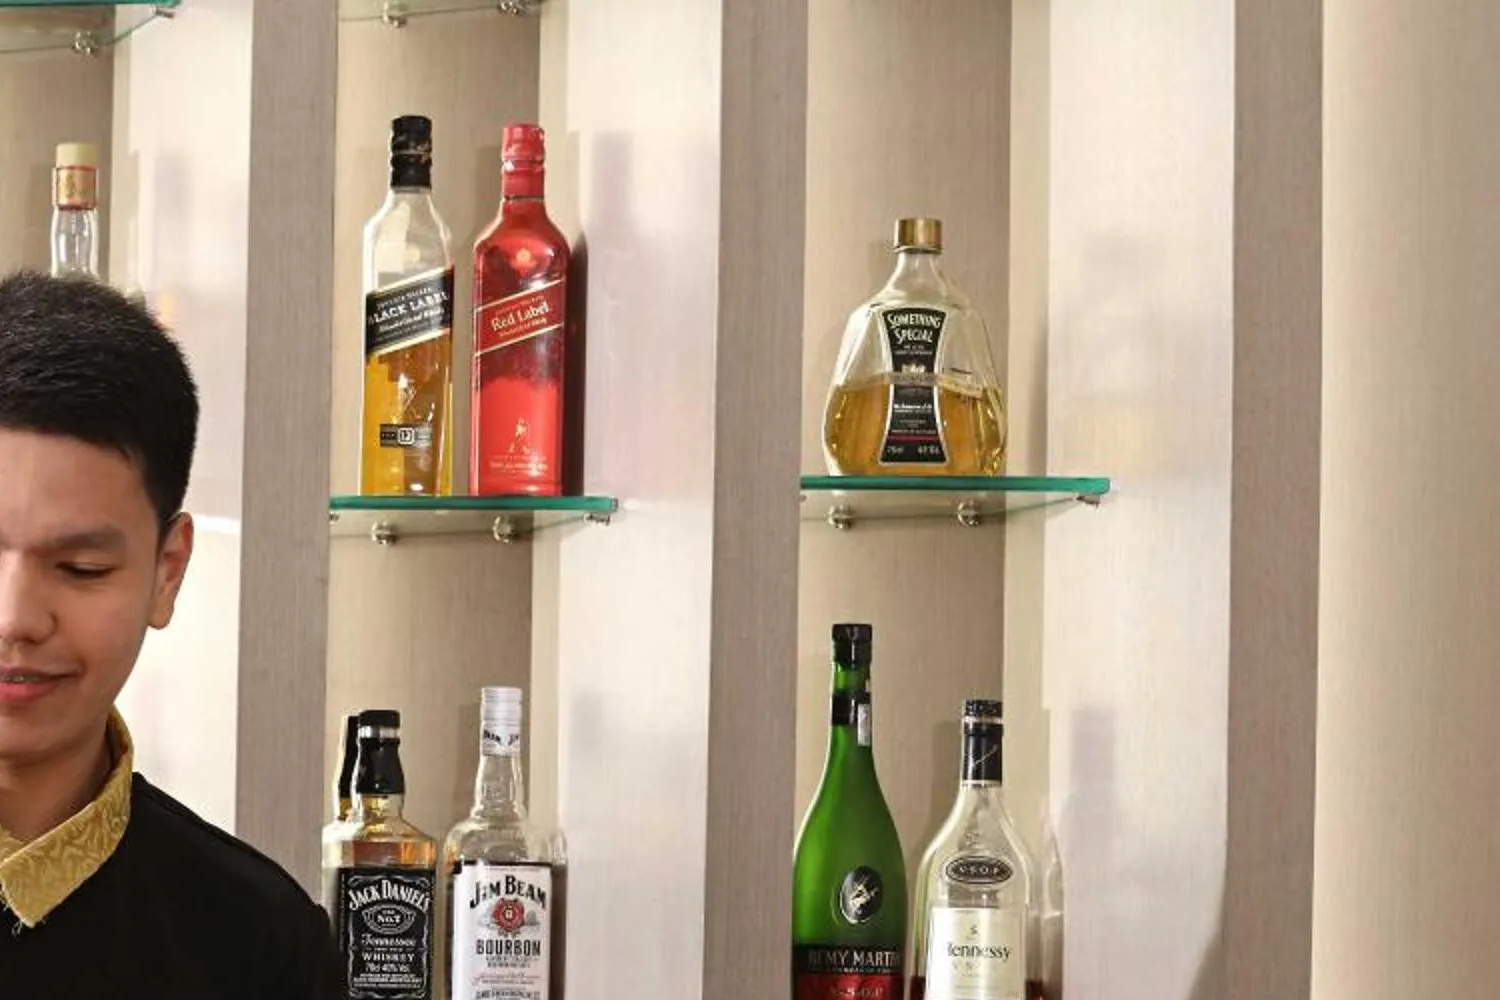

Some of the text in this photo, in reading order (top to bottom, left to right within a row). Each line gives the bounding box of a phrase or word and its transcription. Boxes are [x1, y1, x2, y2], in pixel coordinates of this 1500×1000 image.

[492, 311, 516, 331] Red
[517, 300, 549, 322] Label
[887, 313, 941, 328] SOMETHING
[894, 328, 933, 345] SPECIAL
[348, 885, 381, 911] JACK
[470, 874, 547, 909] JIM BEAM
[476, 939, 541, 956] BOURBON
